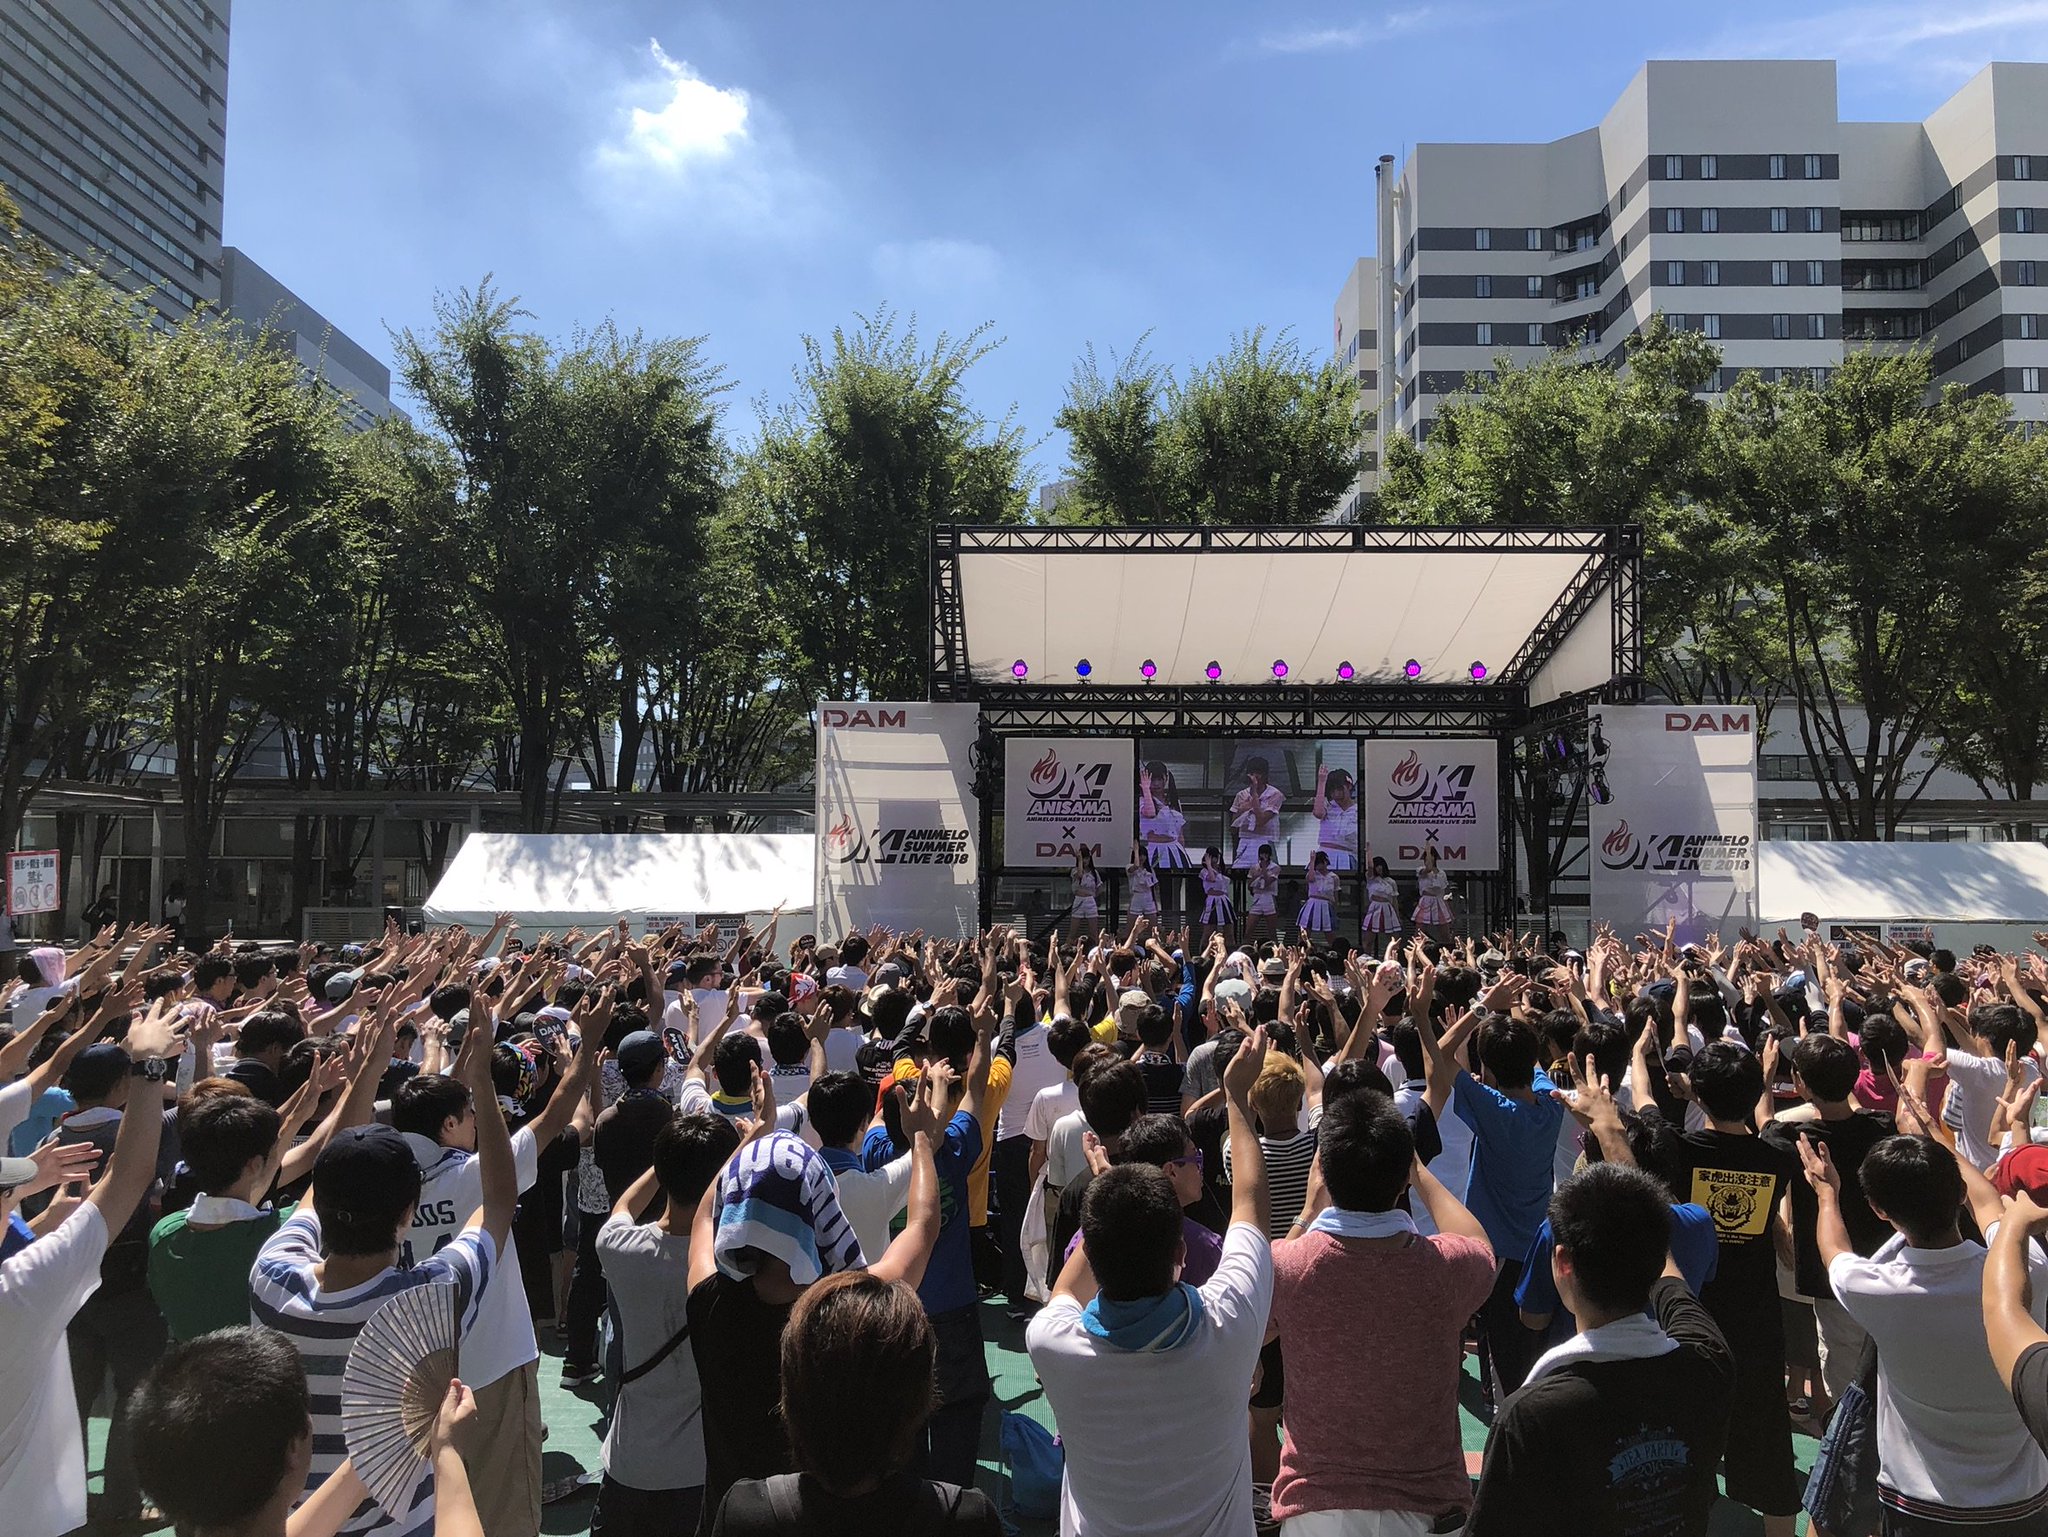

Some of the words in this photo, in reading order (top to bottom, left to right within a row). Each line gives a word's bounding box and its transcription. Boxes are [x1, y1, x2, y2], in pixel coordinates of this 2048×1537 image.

[823, 709, 905, 728] DAM
[1665, 713, 1750, 732] DAM
[1027, 800, 1112, 816] ANISAMA
[1388, 801, 1477, 818] ANISAMA
[906, 829, 969, 841] ANIMELO
[1684, 835, 1750, 846] ANIMELO
[903, 841, 966, 853] SUMMER
[1682, 847, 1747, 859] SUMMER
[900, 853, 932, 864] LIVE
[934, 853, 968, 865] 2018
[1678, 859, 1712, 871] LIVE
[1714, 859, 1750, 871] 2018
[539, 1023, 562, 1037] DAM
[669, 1033, 684, 1060] DAM
[1699, 1170, 1772, 1187] 家虎出没注意
